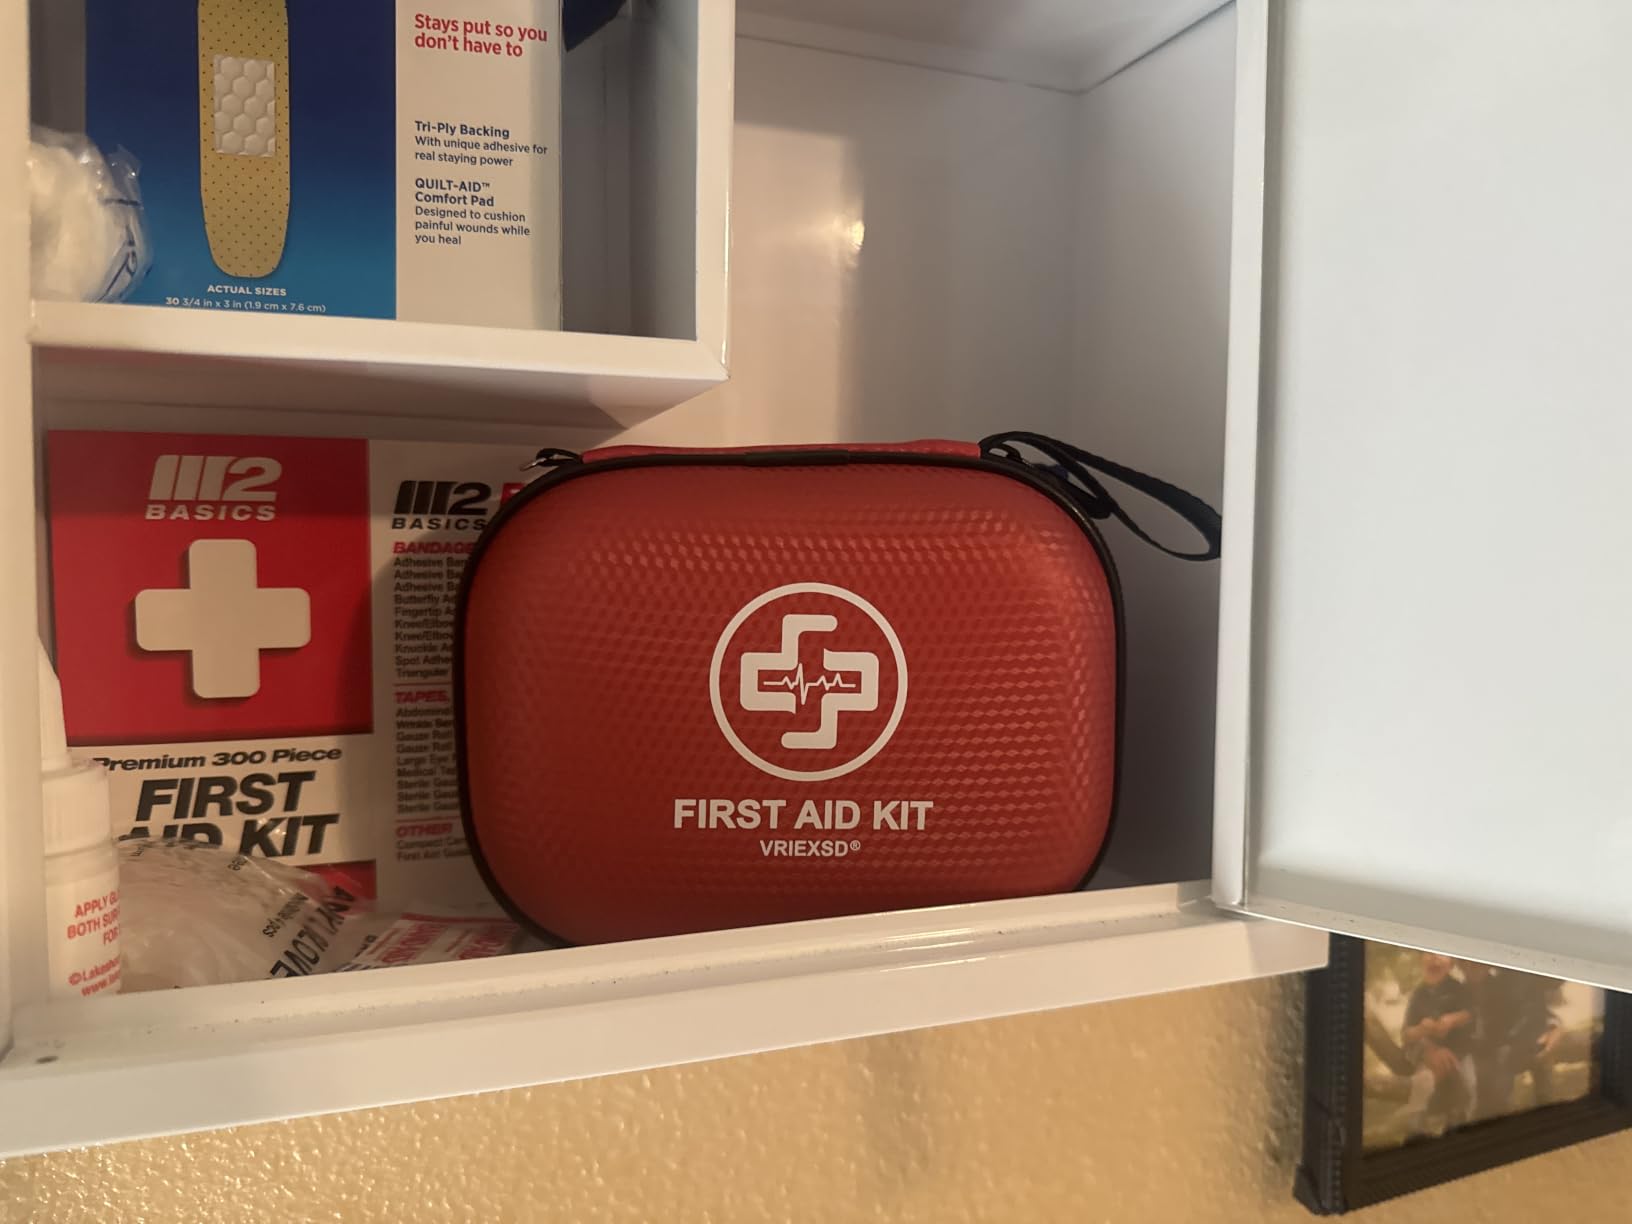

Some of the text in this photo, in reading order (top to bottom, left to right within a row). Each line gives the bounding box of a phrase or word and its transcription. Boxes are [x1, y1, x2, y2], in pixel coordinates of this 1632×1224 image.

[415, 13, 548, 42] Stays put so you
[415, 32, 523, 57] don't have to
[415, 120, 510, 139] Tri-Ply Backing
[415, 135, 548, 155] With unique adhesive for
[415, 151, 513, 167] real staying power
[415, 191, 495, 207] Comfort Pad
[415, 206, 526, 222] Designed to cushion
[415, 221, 530, 236] painful wounds while
[415, 234, 462, 245] you heal
[207, 284, 287, 297] ACTUAL SIZES
[165, 296, 327, 314] 30 3/4 in x 3 in (1.9 cm x 7.6 cm)
[144, 503, 276, 521] BASICS
[391, 517, 487, 530] BASICS
[93, 748, 343, 771] Premium 300 Piece
[135, 770, 317, 822] FIRST
[674, 798, 934, 831] FIRST AID KIT
[238, 813, 340, 858] KIT
[75, 895, 109, 919] APPLY
[67, 917, 100, 939] BOTH
